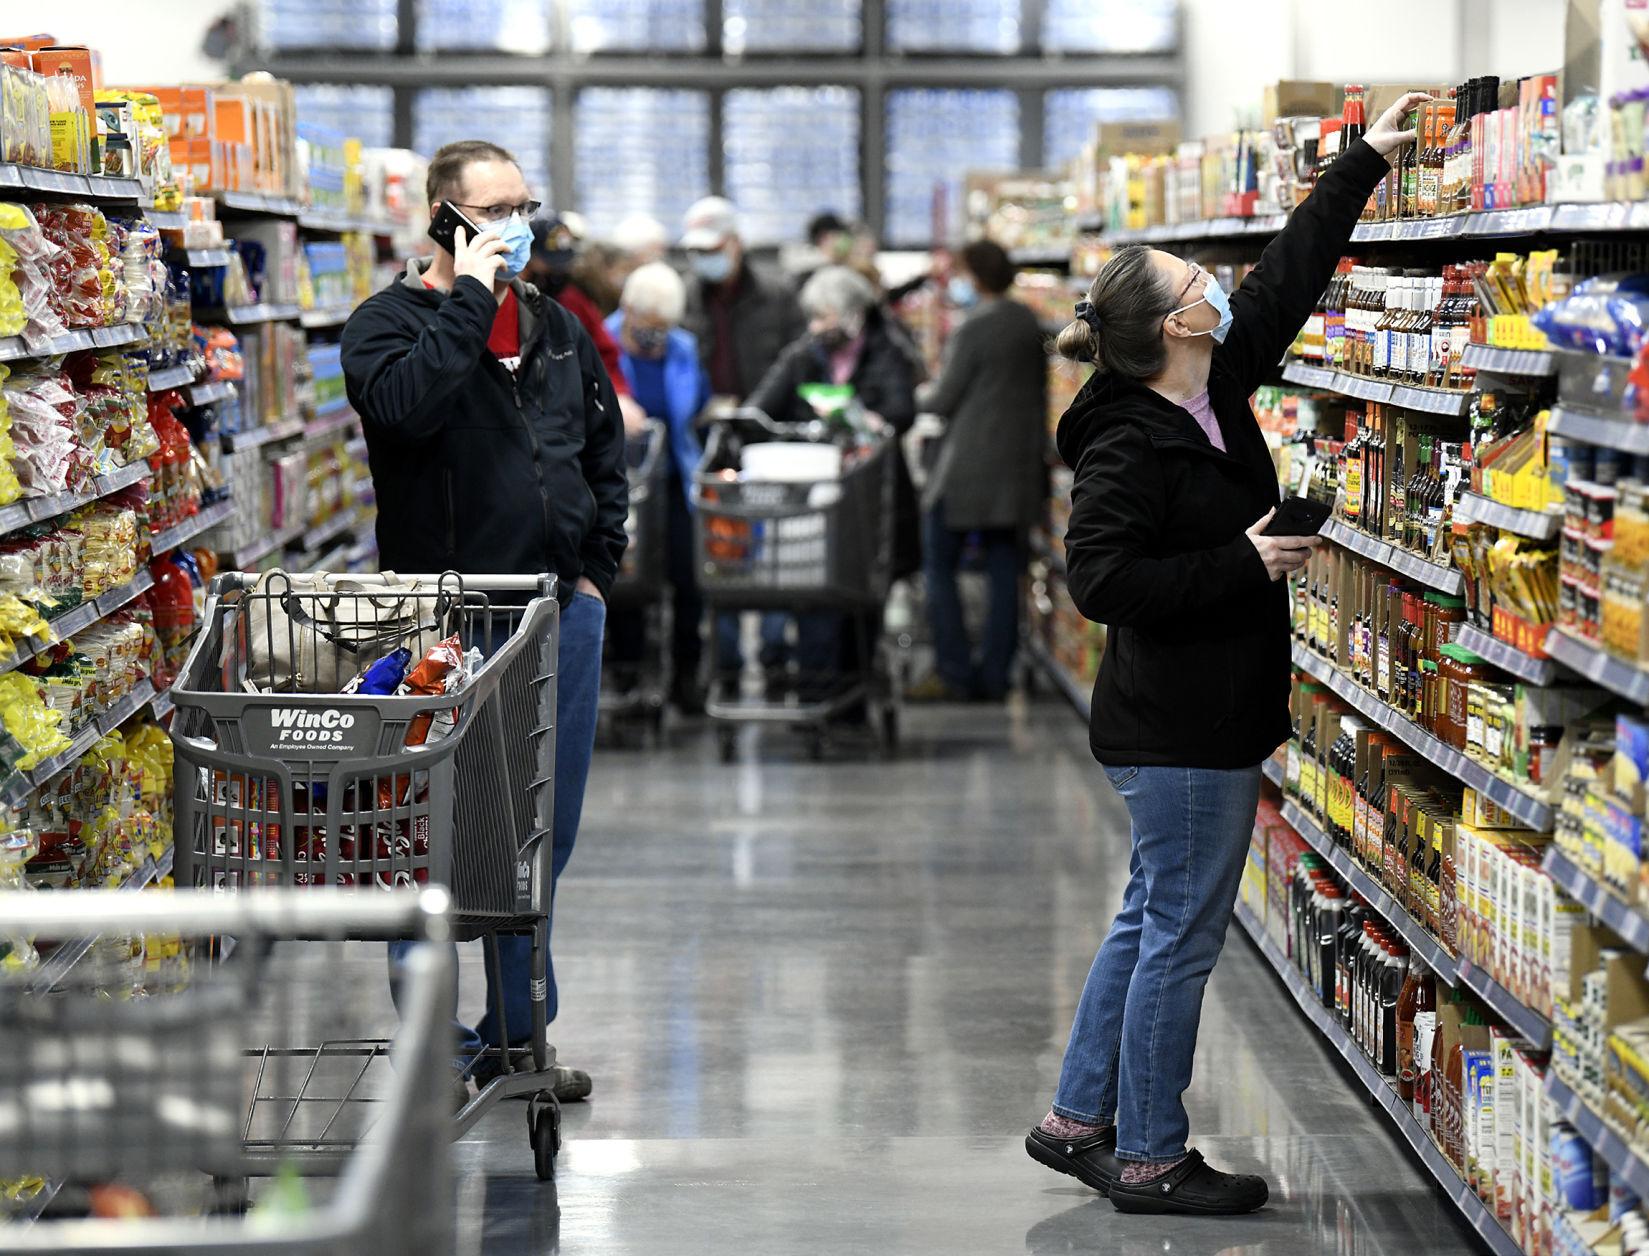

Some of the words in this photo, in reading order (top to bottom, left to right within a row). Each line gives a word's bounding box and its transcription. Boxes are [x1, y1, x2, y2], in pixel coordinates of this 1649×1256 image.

[271, 708, 355, 729] WinCo
[279, 729, 343, 742] FOODS
[279, 743, 306, 751] Employee
